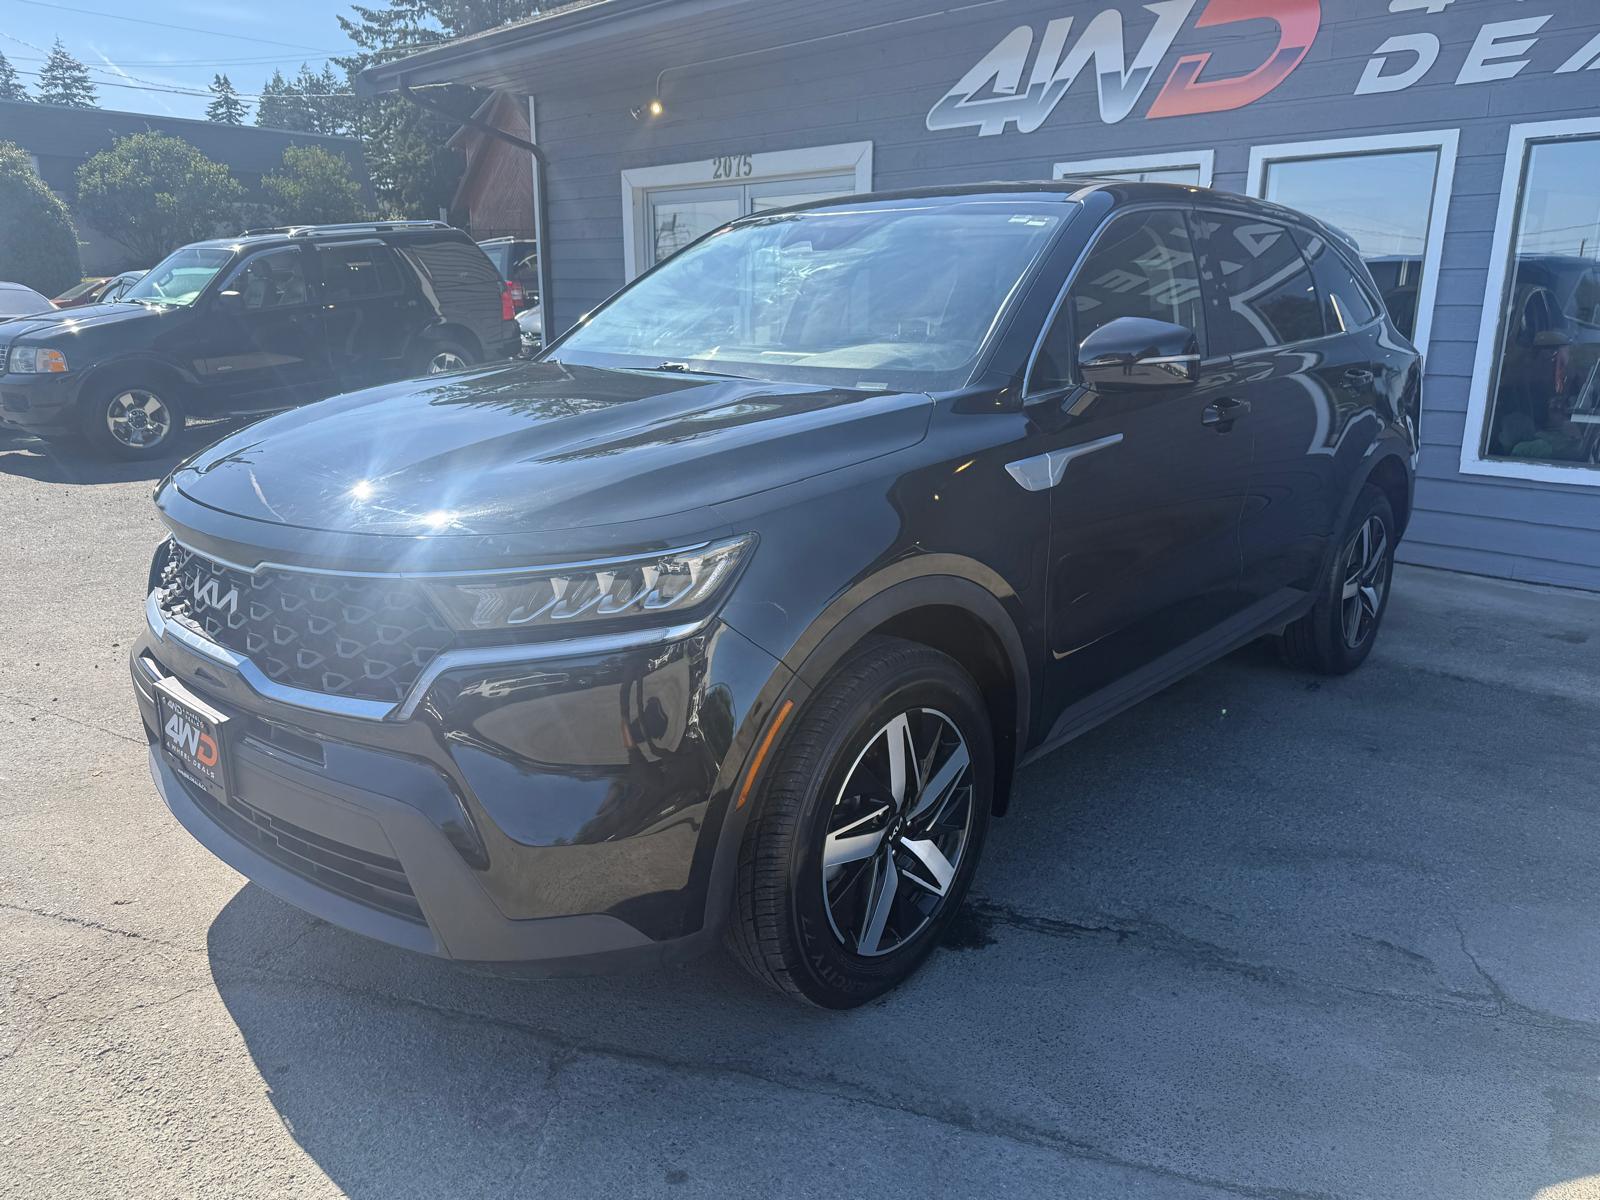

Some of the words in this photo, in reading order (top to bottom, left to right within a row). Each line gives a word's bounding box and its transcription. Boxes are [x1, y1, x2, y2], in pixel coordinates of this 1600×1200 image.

[926, 0, 1321, 137] 4WD
[712, 155, 753, 180] 2075
[165, 713, 219, 767] 4WD
